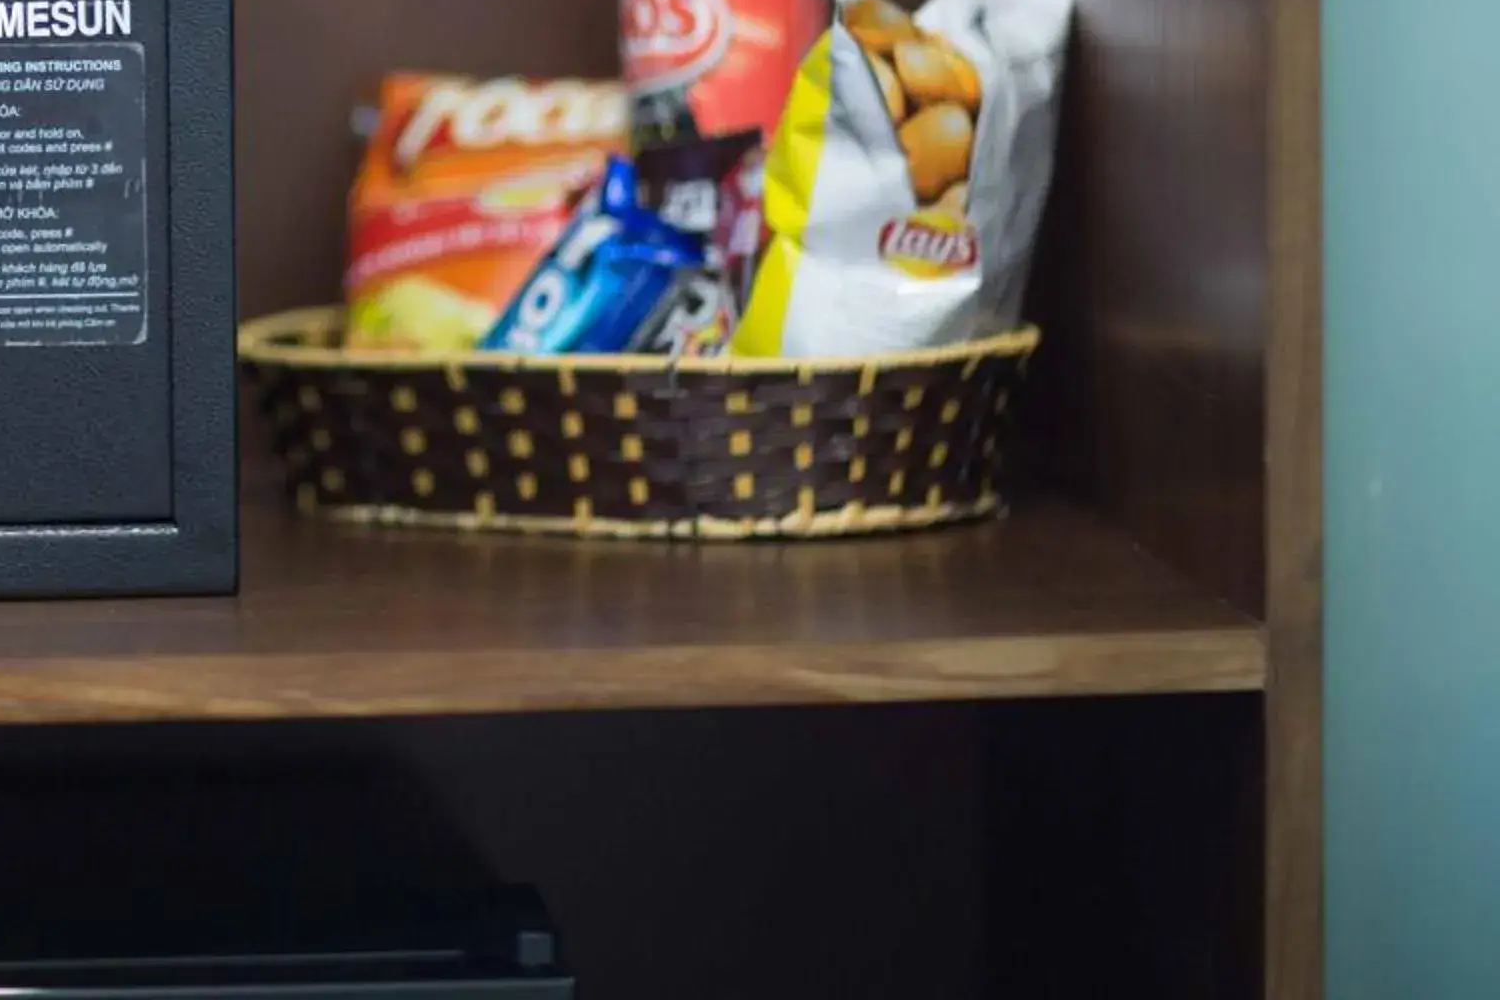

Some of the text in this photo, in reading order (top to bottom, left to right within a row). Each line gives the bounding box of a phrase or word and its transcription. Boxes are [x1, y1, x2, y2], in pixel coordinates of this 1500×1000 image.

[25, 59, 122, 73] INSTRUCTIONS
[13, 128, 37, 140] and
[38, 127, 64, 139] hold
[7, 142, 43, 154] codes
[45, 142, 67, 153] and
[70, 142, 102, 155] press
[30, 228, 63, 241] press
[0, 242, 31, 255] open
